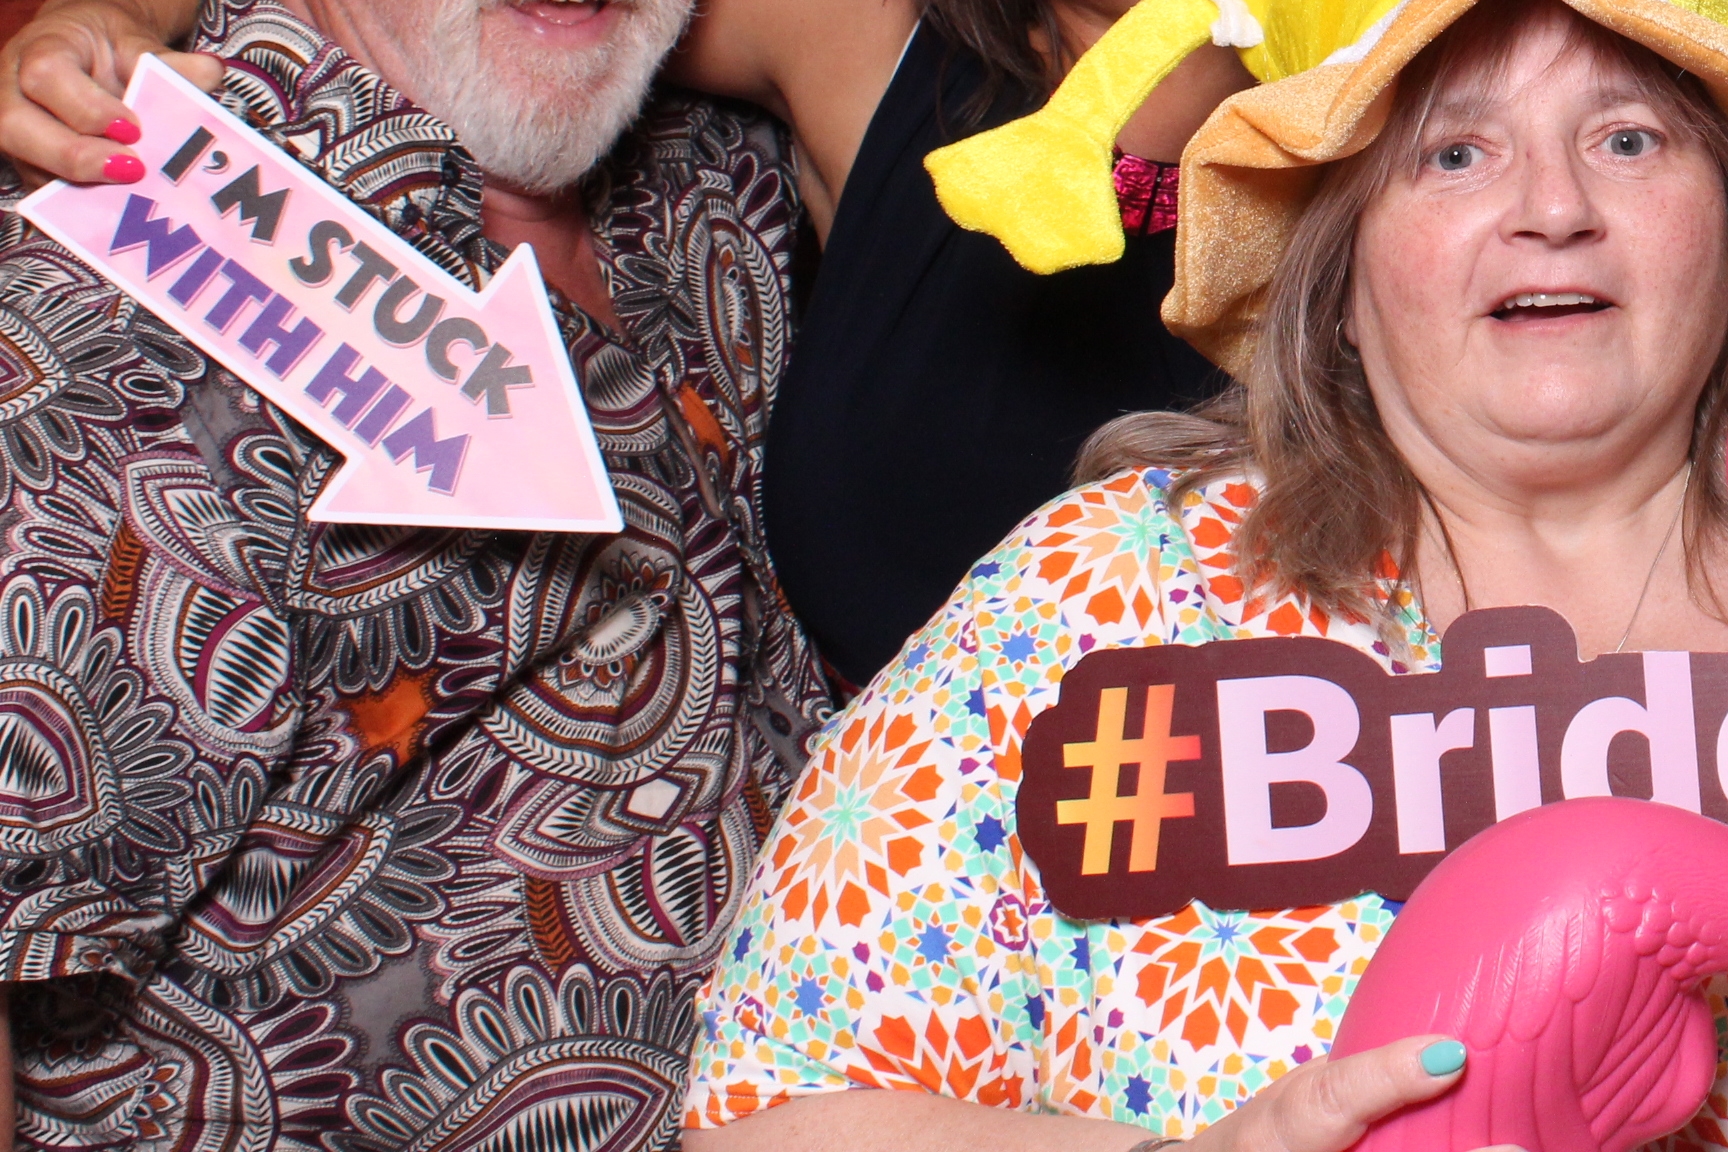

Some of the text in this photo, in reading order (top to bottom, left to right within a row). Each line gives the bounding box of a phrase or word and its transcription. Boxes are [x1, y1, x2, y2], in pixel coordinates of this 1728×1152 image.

[108, 192, 472, 497] WITH HIM
[160, 126, 536, 420] I'M STUCK
